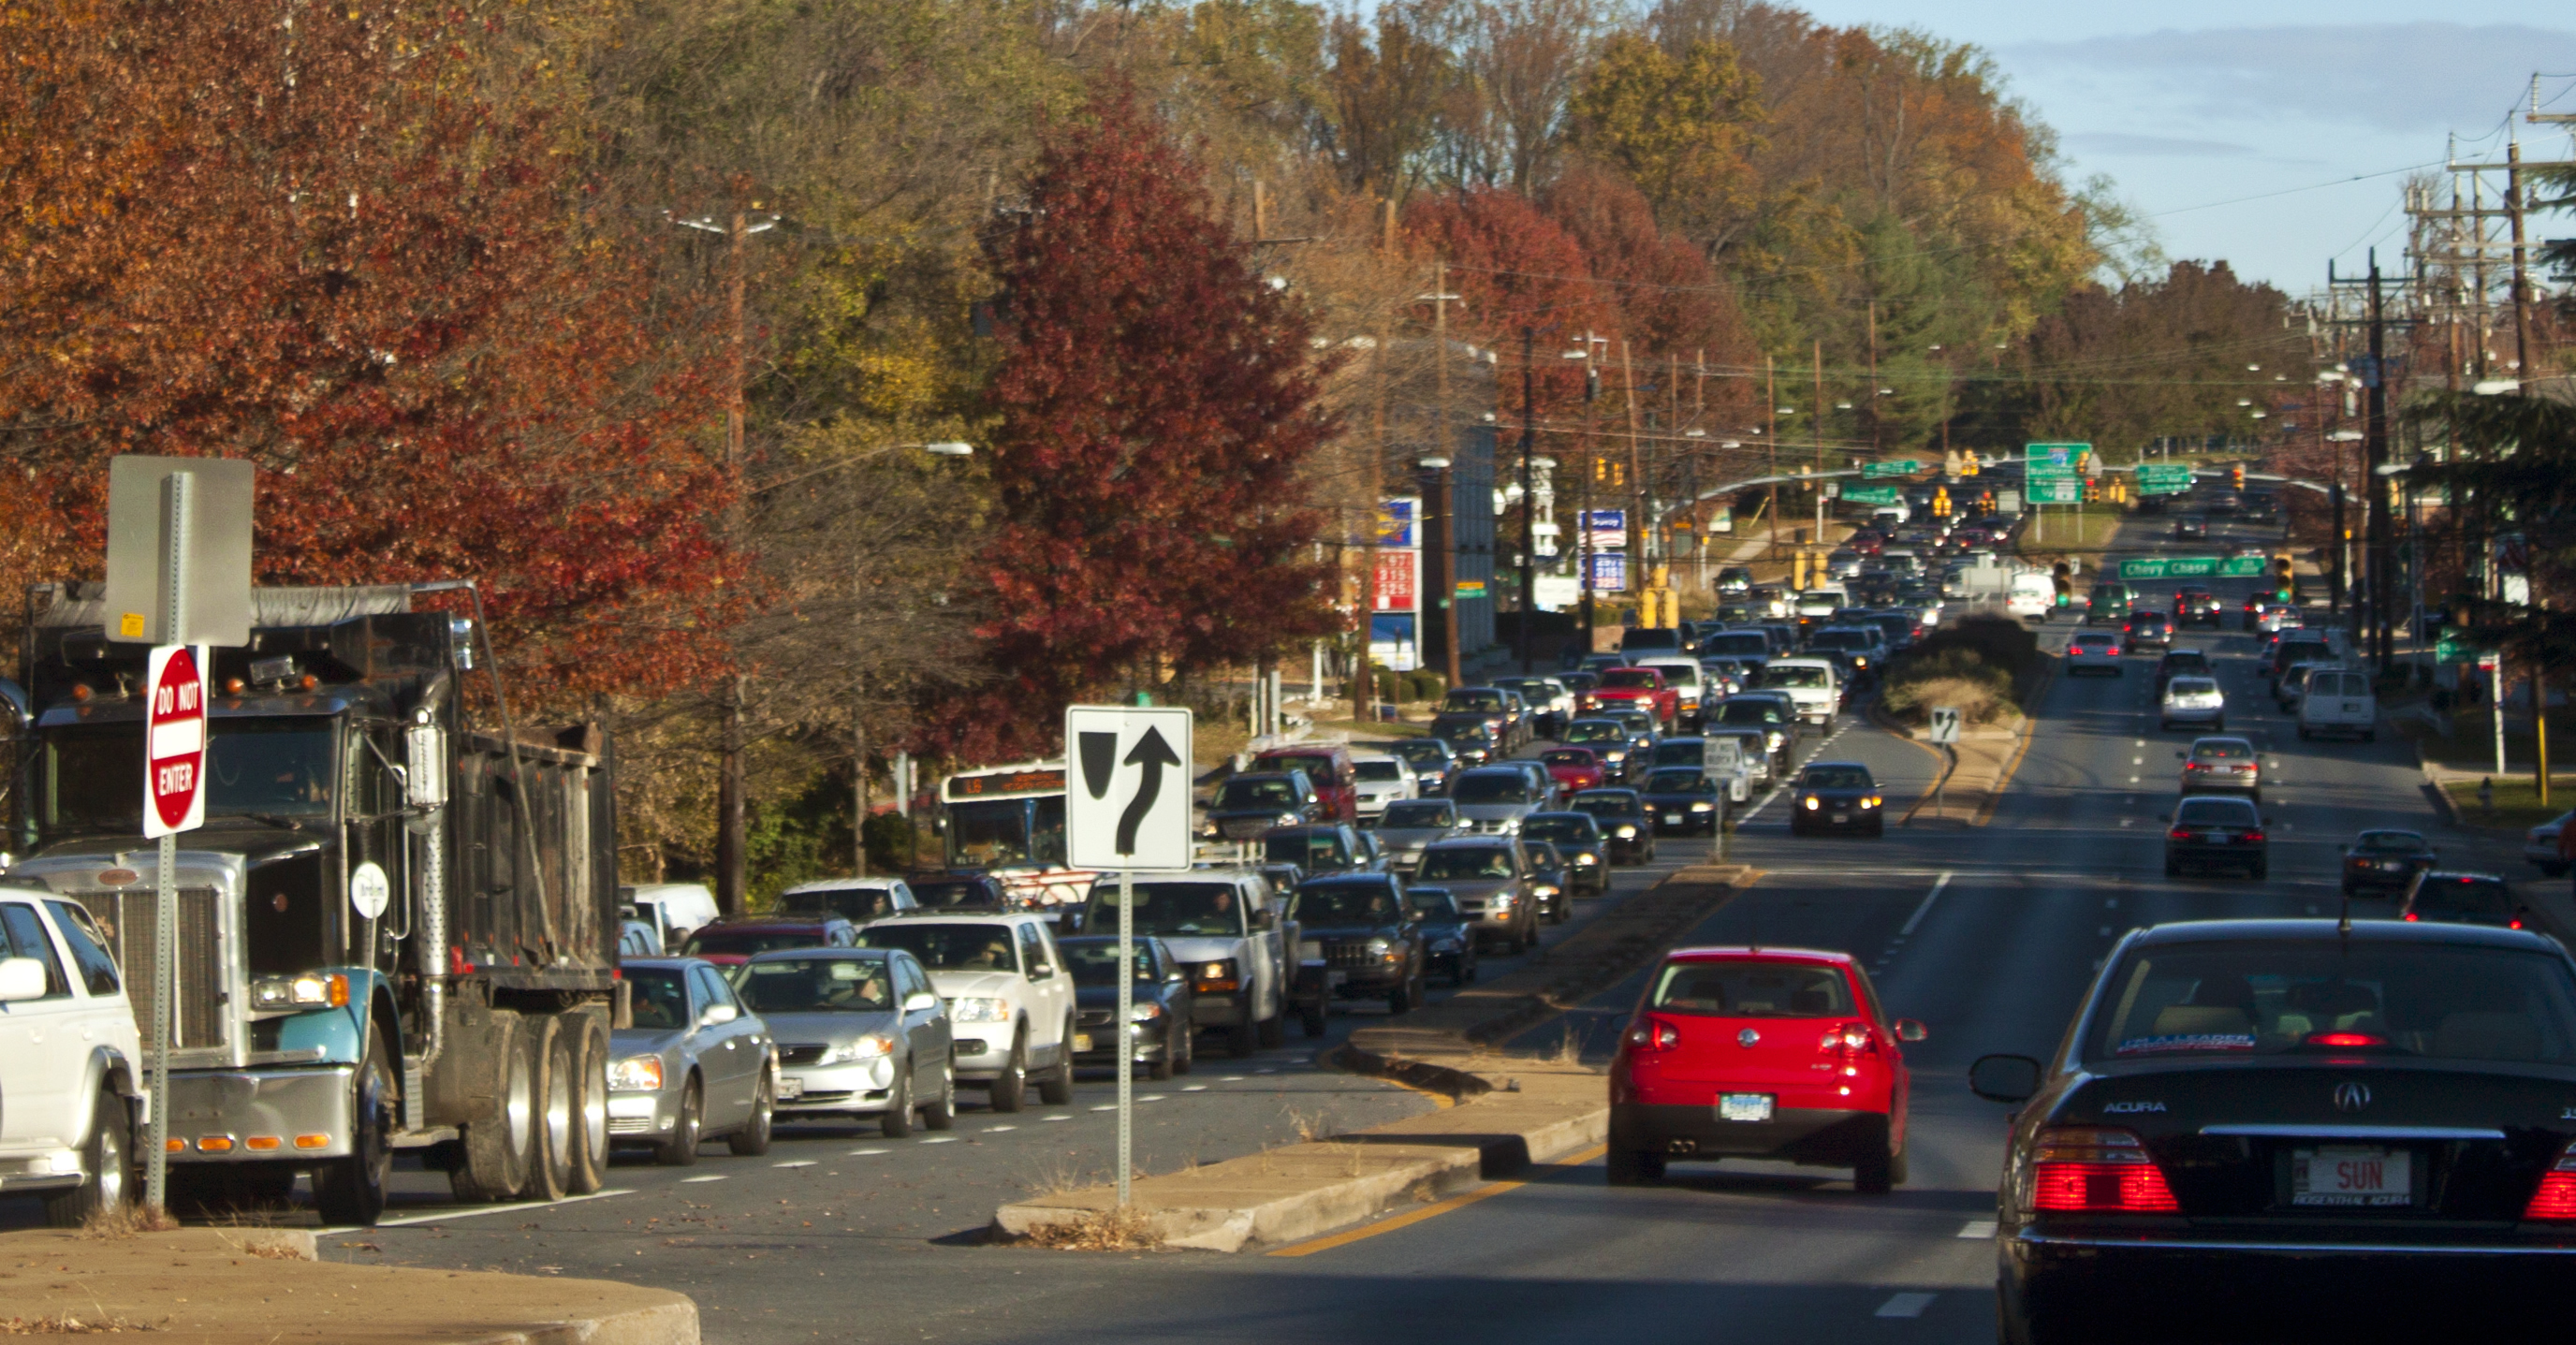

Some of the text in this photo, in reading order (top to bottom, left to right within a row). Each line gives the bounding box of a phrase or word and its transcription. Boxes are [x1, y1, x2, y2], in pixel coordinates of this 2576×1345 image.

[2125, 563, 2164, 577] Chevy
[2171, 563, 2210, 575] Chase
[157, 682, 199, 716] DO NOT
[158, 762, 194, 797] ENTER
[2102, 1101, 2167, 1113] ACURA
[2337, 1161, 2384, 1191] SUN
[2292, 1195, 2411, 1206] ROSENTHAL ACURA
